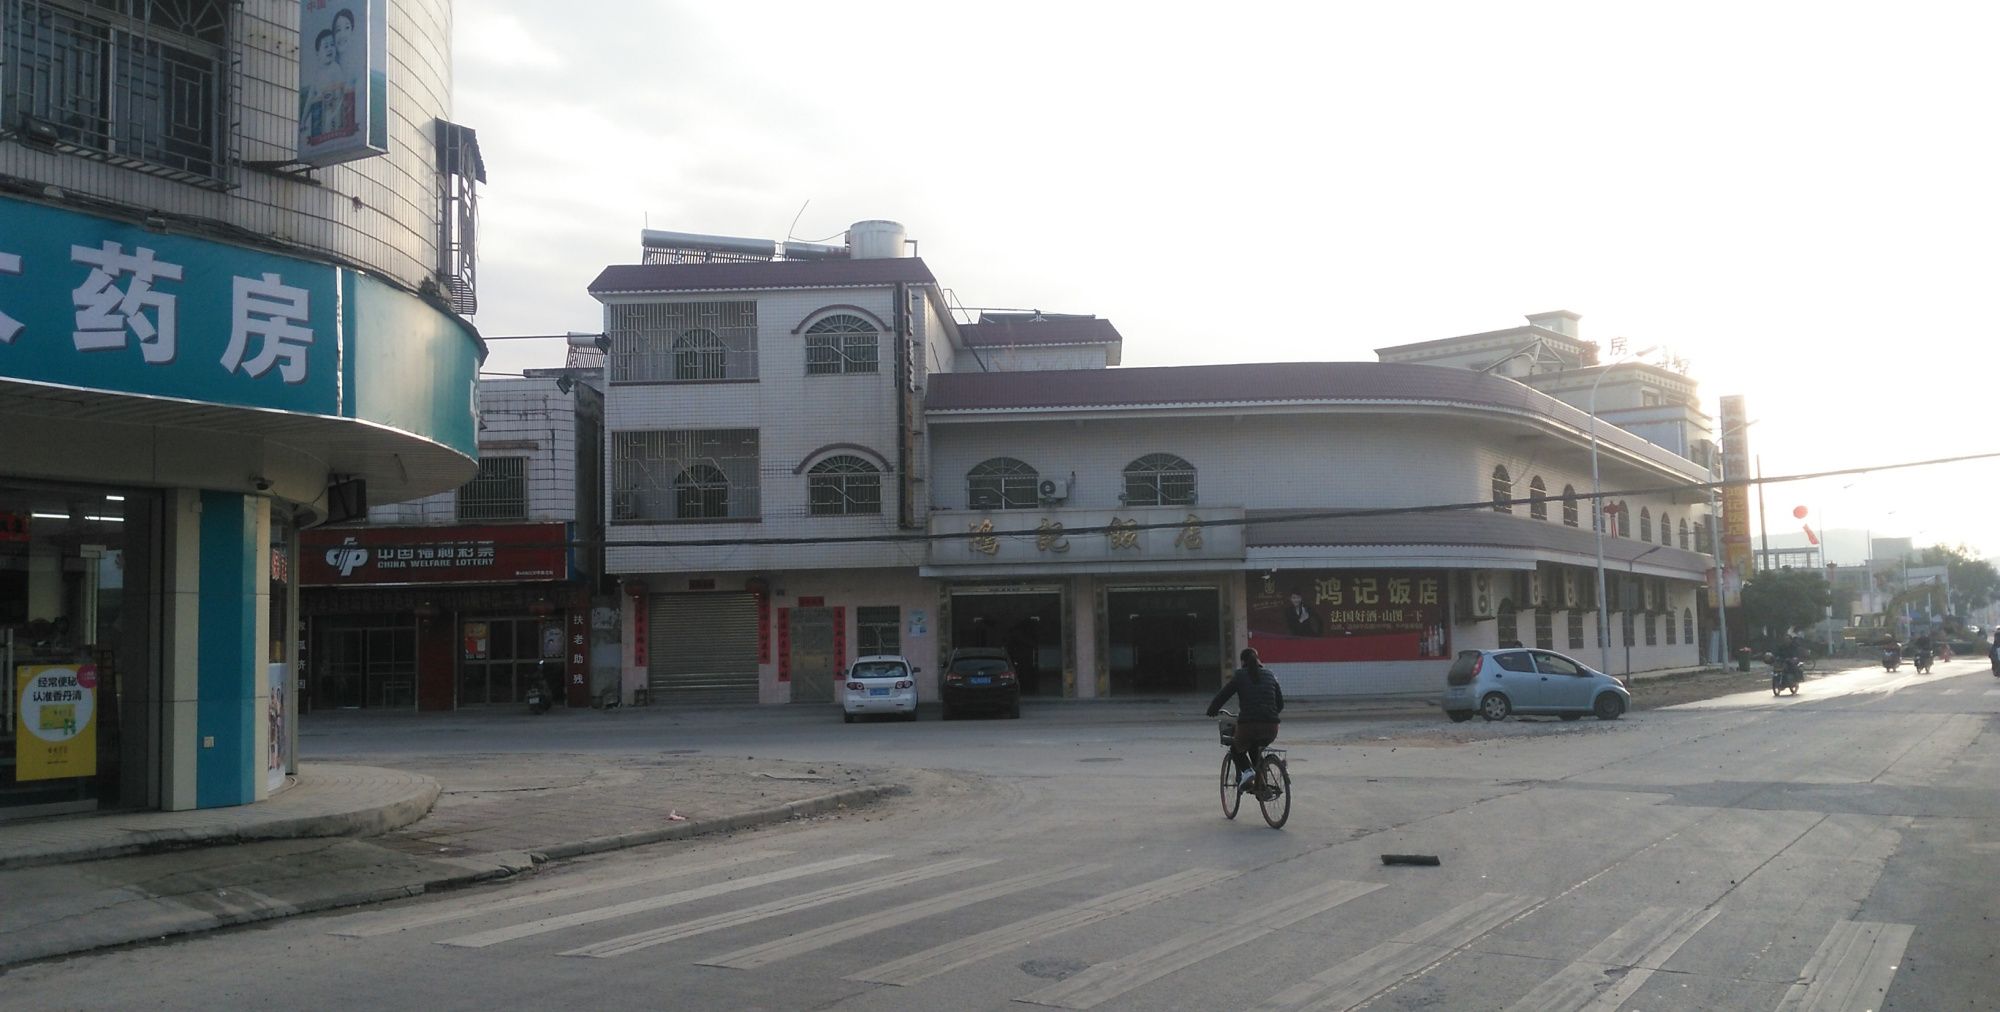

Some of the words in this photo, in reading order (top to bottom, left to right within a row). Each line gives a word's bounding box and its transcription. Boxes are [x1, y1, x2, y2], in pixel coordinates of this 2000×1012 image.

[0, 240, 315, 385] 药房
[377, 558, 406, 569] CHINA
[410, 558, 451, 568] WELFARE
[456, 557, 494, 567] LOTTERY
[1314, 577, 1438, 606] 鸿记饭店
[572, 614, 585, 685] 扶老助残
[37, 676, 78, 688] 经常便秘
